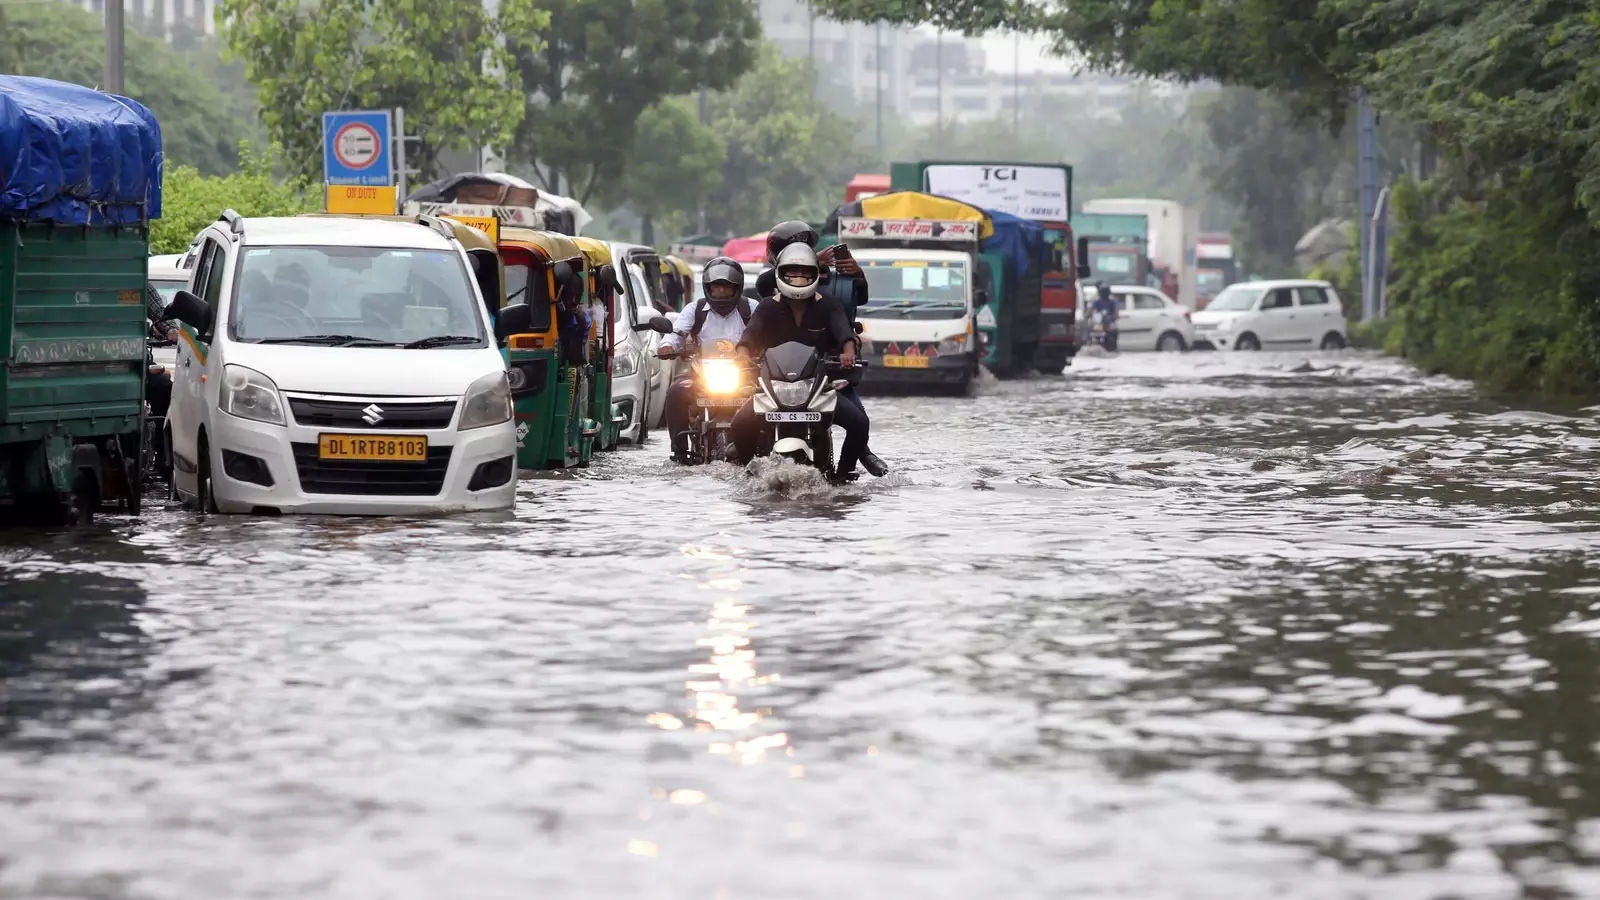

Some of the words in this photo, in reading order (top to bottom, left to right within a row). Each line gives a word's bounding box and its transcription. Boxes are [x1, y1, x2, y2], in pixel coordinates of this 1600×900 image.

[981, 167, 1017, 181] TCI
[346, 187, 355, 199] ON
[358, 187, 377, 199] DUTY
[788, 413, 797, 421] CS
[329, 439, 424, 456] DL1RTB8103
